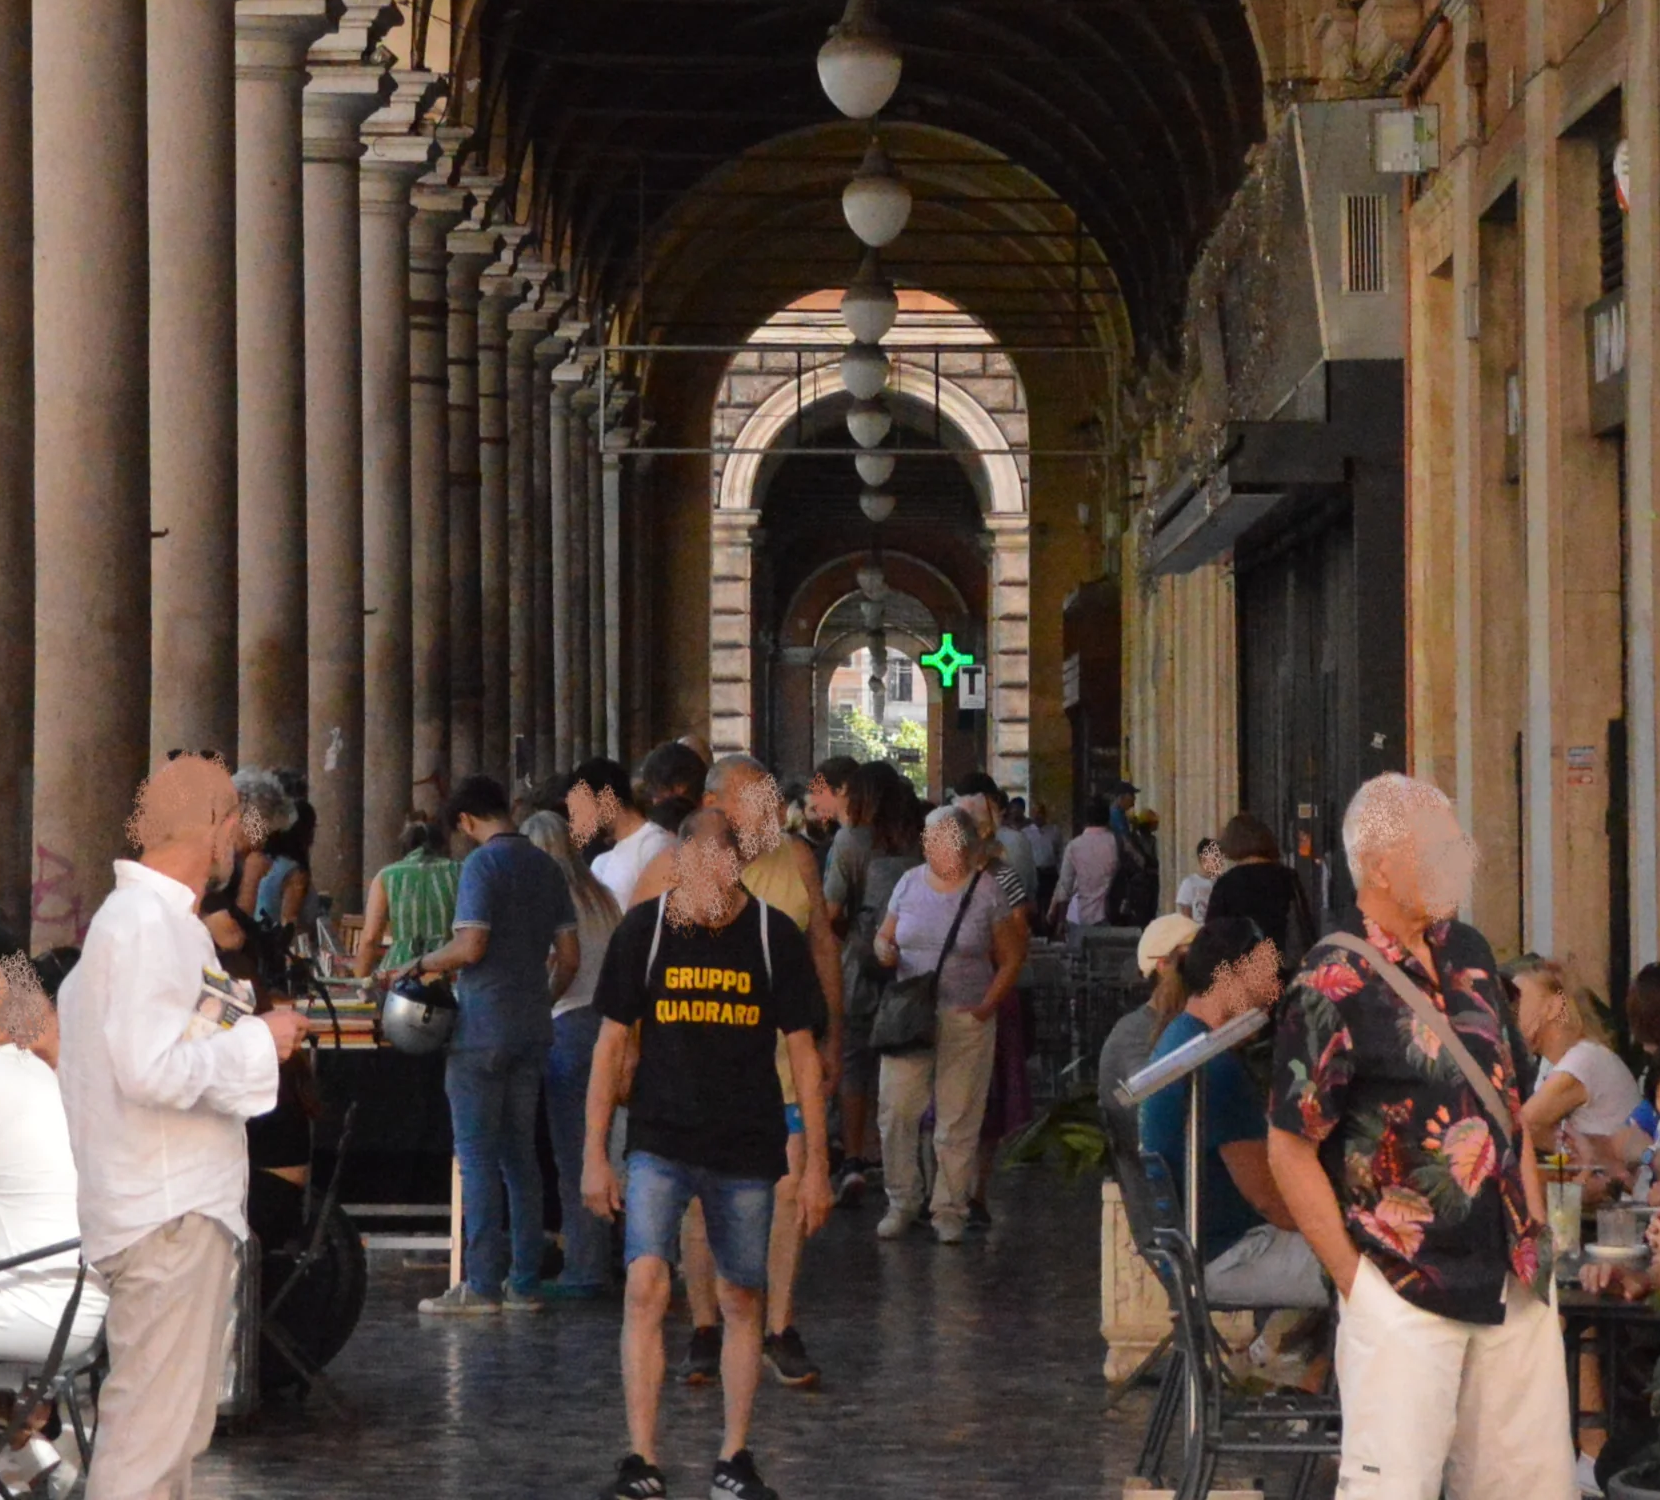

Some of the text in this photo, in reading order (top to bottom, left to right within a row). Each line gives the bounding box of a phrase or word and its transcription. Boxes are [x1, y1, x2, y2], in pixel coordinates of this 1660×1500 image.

[962, 667, 982, 695] T
[665, 966, 751, 994] GRUPPO
[656, 999, 761, 1026] QUADRARO
